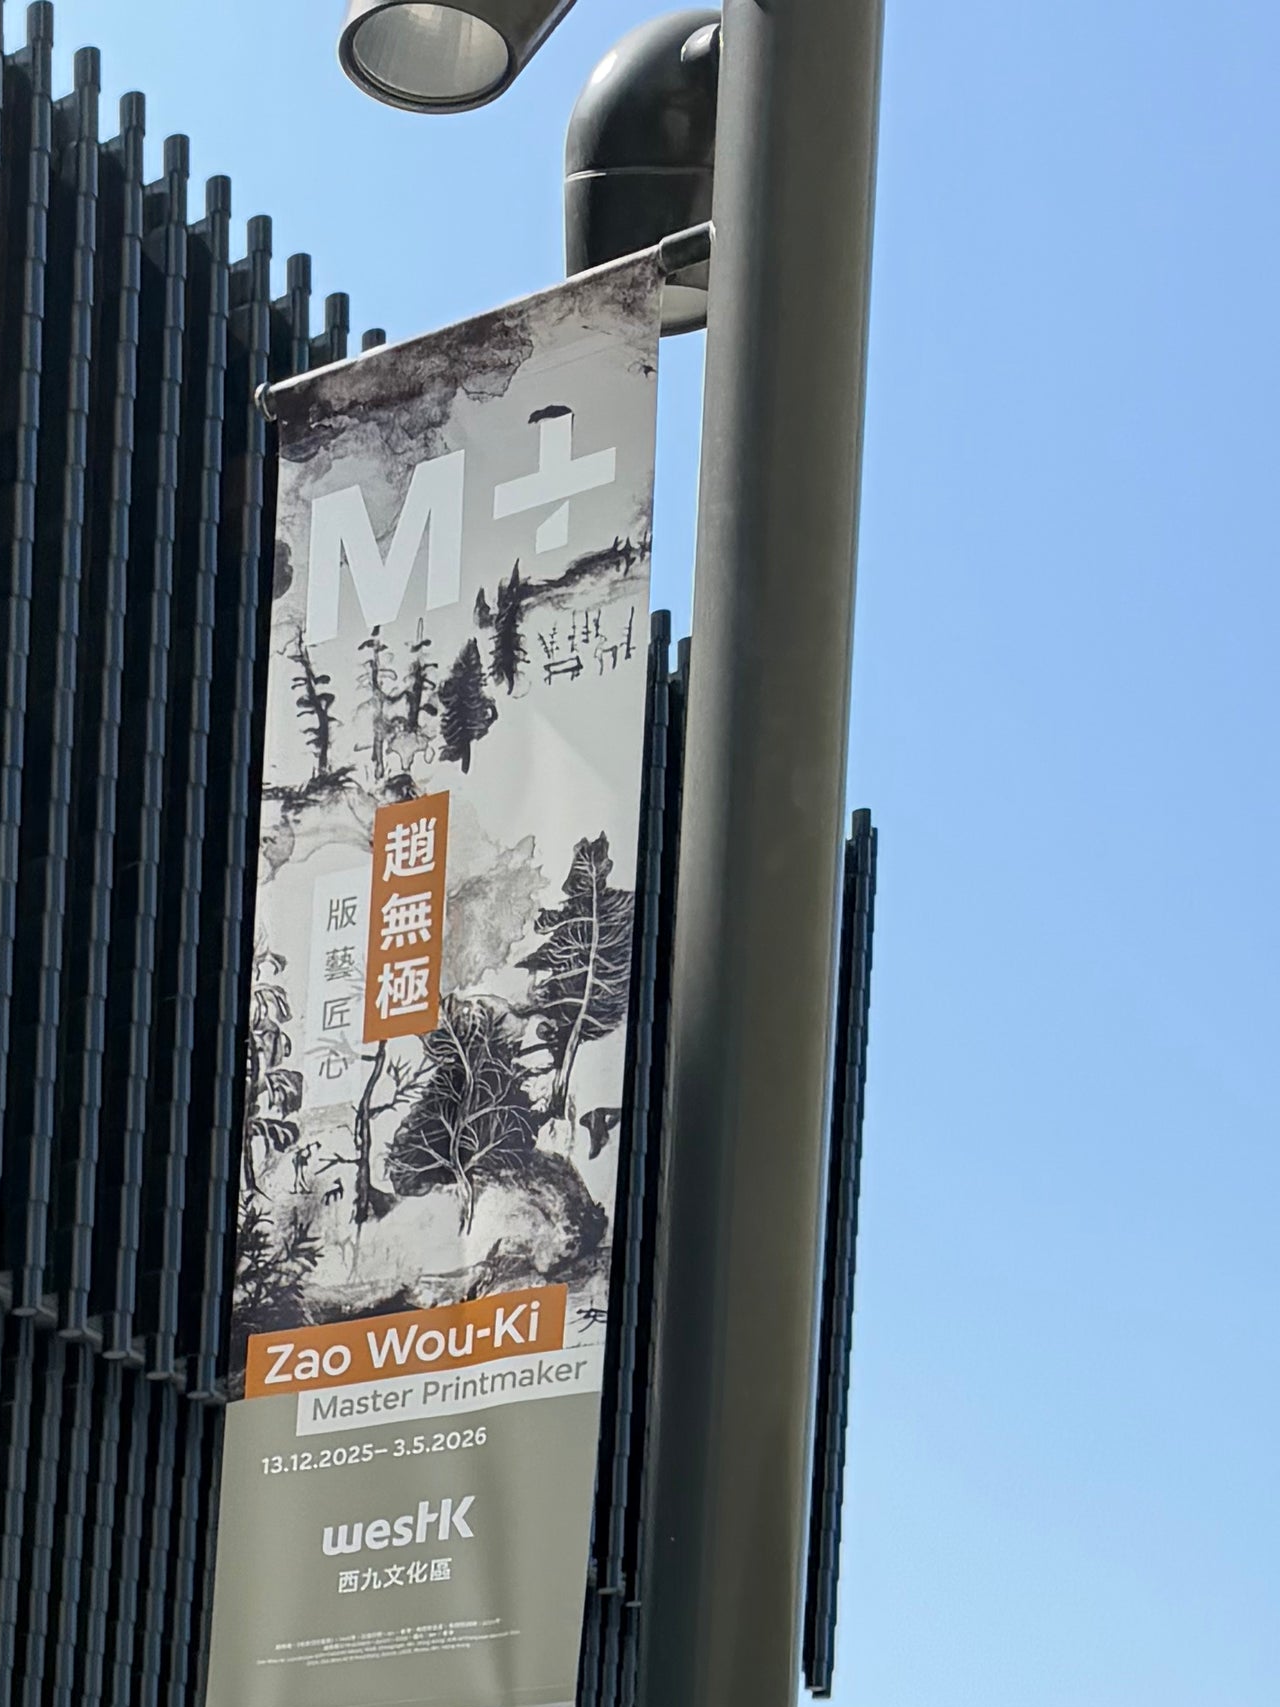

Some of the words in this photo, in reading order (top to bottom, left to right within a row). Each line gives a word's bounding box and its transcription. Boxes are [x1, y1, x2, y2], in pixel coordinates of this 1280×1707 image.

[306, 404, 616, 645] M+
[376, 816, 436, 1021] 趙無極
[317, 896, 359, 1082] 版藝匠心
[263, 1342, 351, 1385] Zao
[365, 1300, 540, 1369] Wou-Ki
[311, 1388, 414, 1422] Master
[421, 1356, 589, 1406] Printmaker
[392, 1426, 488, 1458] 3.5.2026
[337, 1556, 453, 1594] 西九文化區
